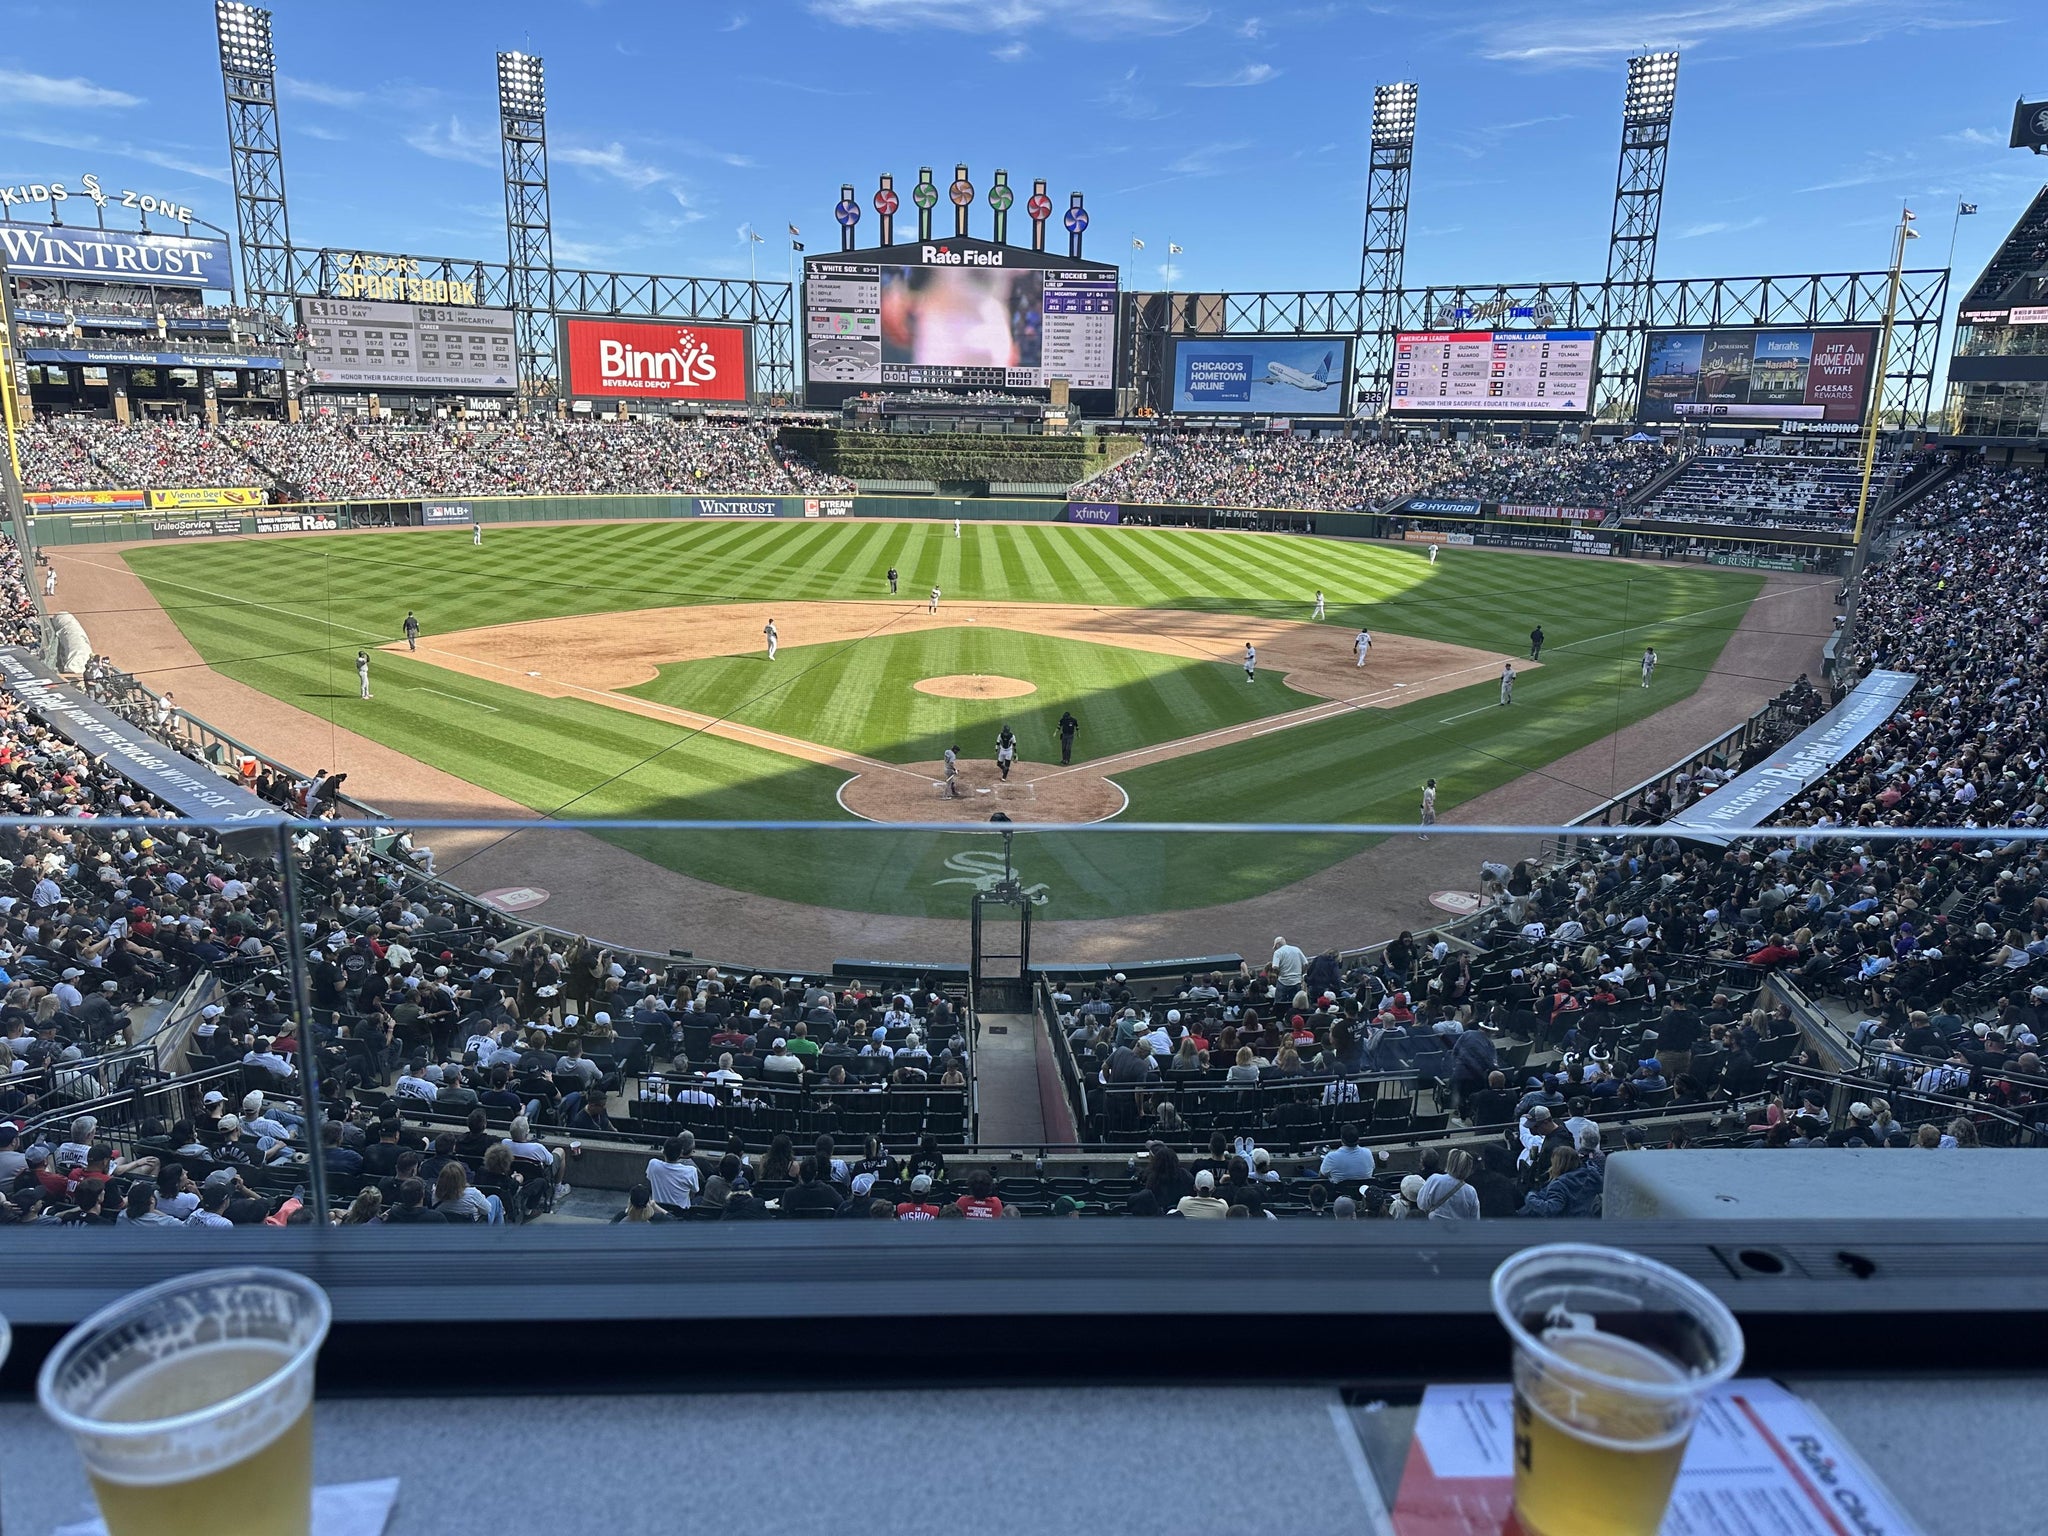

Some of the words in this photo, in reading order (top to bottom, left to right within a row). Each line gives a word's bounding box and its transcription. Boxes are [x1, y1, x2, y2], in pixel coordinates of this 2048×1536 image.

[0, 183, 68, 206] KIDS
[121, 190, 193, 224] ZONE
[922, 245, 961, 265] Rate
[964, 251, 1003, 266] Field
[337, 254, 419, 274] CAESARS
[1060, 272, 1088, 280] ROCKIES
[338, 274, 477, 304] SPORTSBOOK
[330, 304, 348, 316] 18
[1455, 308, 1472, 319] IT'S
[1469, 299, 1522, 324] Miller
[1510, 307, 1535, 318] TIME
[437, 311, 454, 322] 31
[457, 317, 494, 325] MCCARTHY
[1768, 341, 1800, 351] Harrah's
[1826, 344, 1845, 353] HIT
[1846, 344, 1855, 353] A
[89, 352, 128, 362] Hometown
[129, 354, 157, 364] Banking
[1814, 353, 1841, 366] HOME
[1843, 353, 1864, 366] RUN
[1191, 361, 1244, 371] CHICAGO'S
[1823, 366, 1852, 375] WITH
[1191, 372, 1247, 381] HOMETOWN
[602, 379, 644, 388] BEVERAGE
[644, 380, 671, 389] DEPOT
[1190, 382, 1225, 390] AIRLINE
[470, 398, 500, 410] Modelo
[867, 406, 878, 414] DECK
[1782, 420, 1805, 434] Lite
[1808, 423, 1860, 433] LANDING
[50, 494, 92, 507] Surfside
[170, 491, 200, 499] Vienna
[203, 490, 222, 498] Beef
[699, 499, 775, 514] WINTRUST
[820, 500, 853, 508] STREAM
[1427, 503, 1475, 512] HYUNDAI
[827, 507, 846, 516] NOW
[1075, 507, 1111, 521] xfinity
[1215, 509, 1232, 518] THE
[1500, 505, 1558, 518] WHITTINGHAM
[1561, 508, 1590, 519] MEATS
[257, 524, 273, 533] 100%
[272, 524, 280, 532] EN
[280, 521, 302, 531] ESPAÑOL
[301, 515, 337, 530] Rate
[1573, 530, 1595, 541] Rate
[1728, 557, 1755, 568] RUSH
[62, 709, 100, 726] HOME
[84, 724, 111, 732] OF
[99, 731, 127, 750] THE
[113, 742, 170, 770] CHICAGO
[155, 768, 201, 792] WHITE
[193, 790, 236, 808] SOX
[1759, 757, 1819, 782] Rate
[1793, 742, 1842, 765] Field
[1708, 784, 1770, 820] WELCOME
[1760, 778, 1783, 791] TO
[467, 1043, 480, 1052] 13
[61, 1151, 83, 1164] THOME
[1788, 1434, 1838, 1485] Rate
